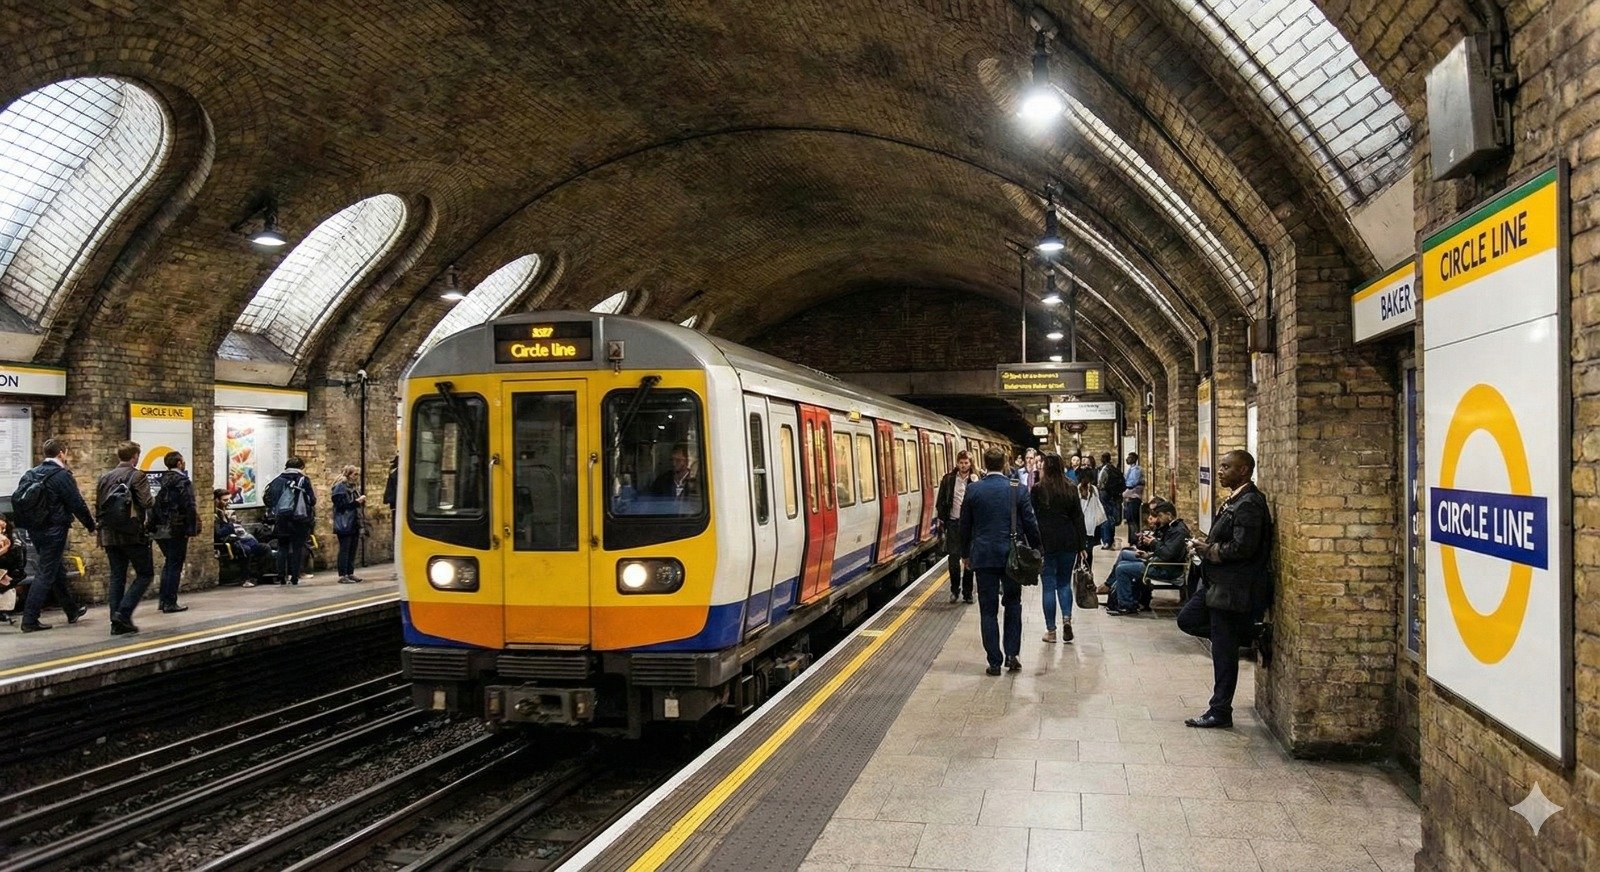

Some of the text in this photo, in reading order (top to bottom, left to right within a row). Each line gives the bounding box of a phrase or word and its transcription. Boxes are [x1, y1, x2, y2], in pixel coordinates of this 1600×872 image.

[1440, 211, 1527, 281] CIRCLE LINE
[1380, 284, 1412, 321] BAKER
[511, 343, 576, 358] Circle line
[0, 374, 19, 387] ON
[140, 407, 184, 417] CIRCLE LINE
[1438, 500, 1489, 541] CIRCLE
[1494, 507, 1534, 550] LINE
